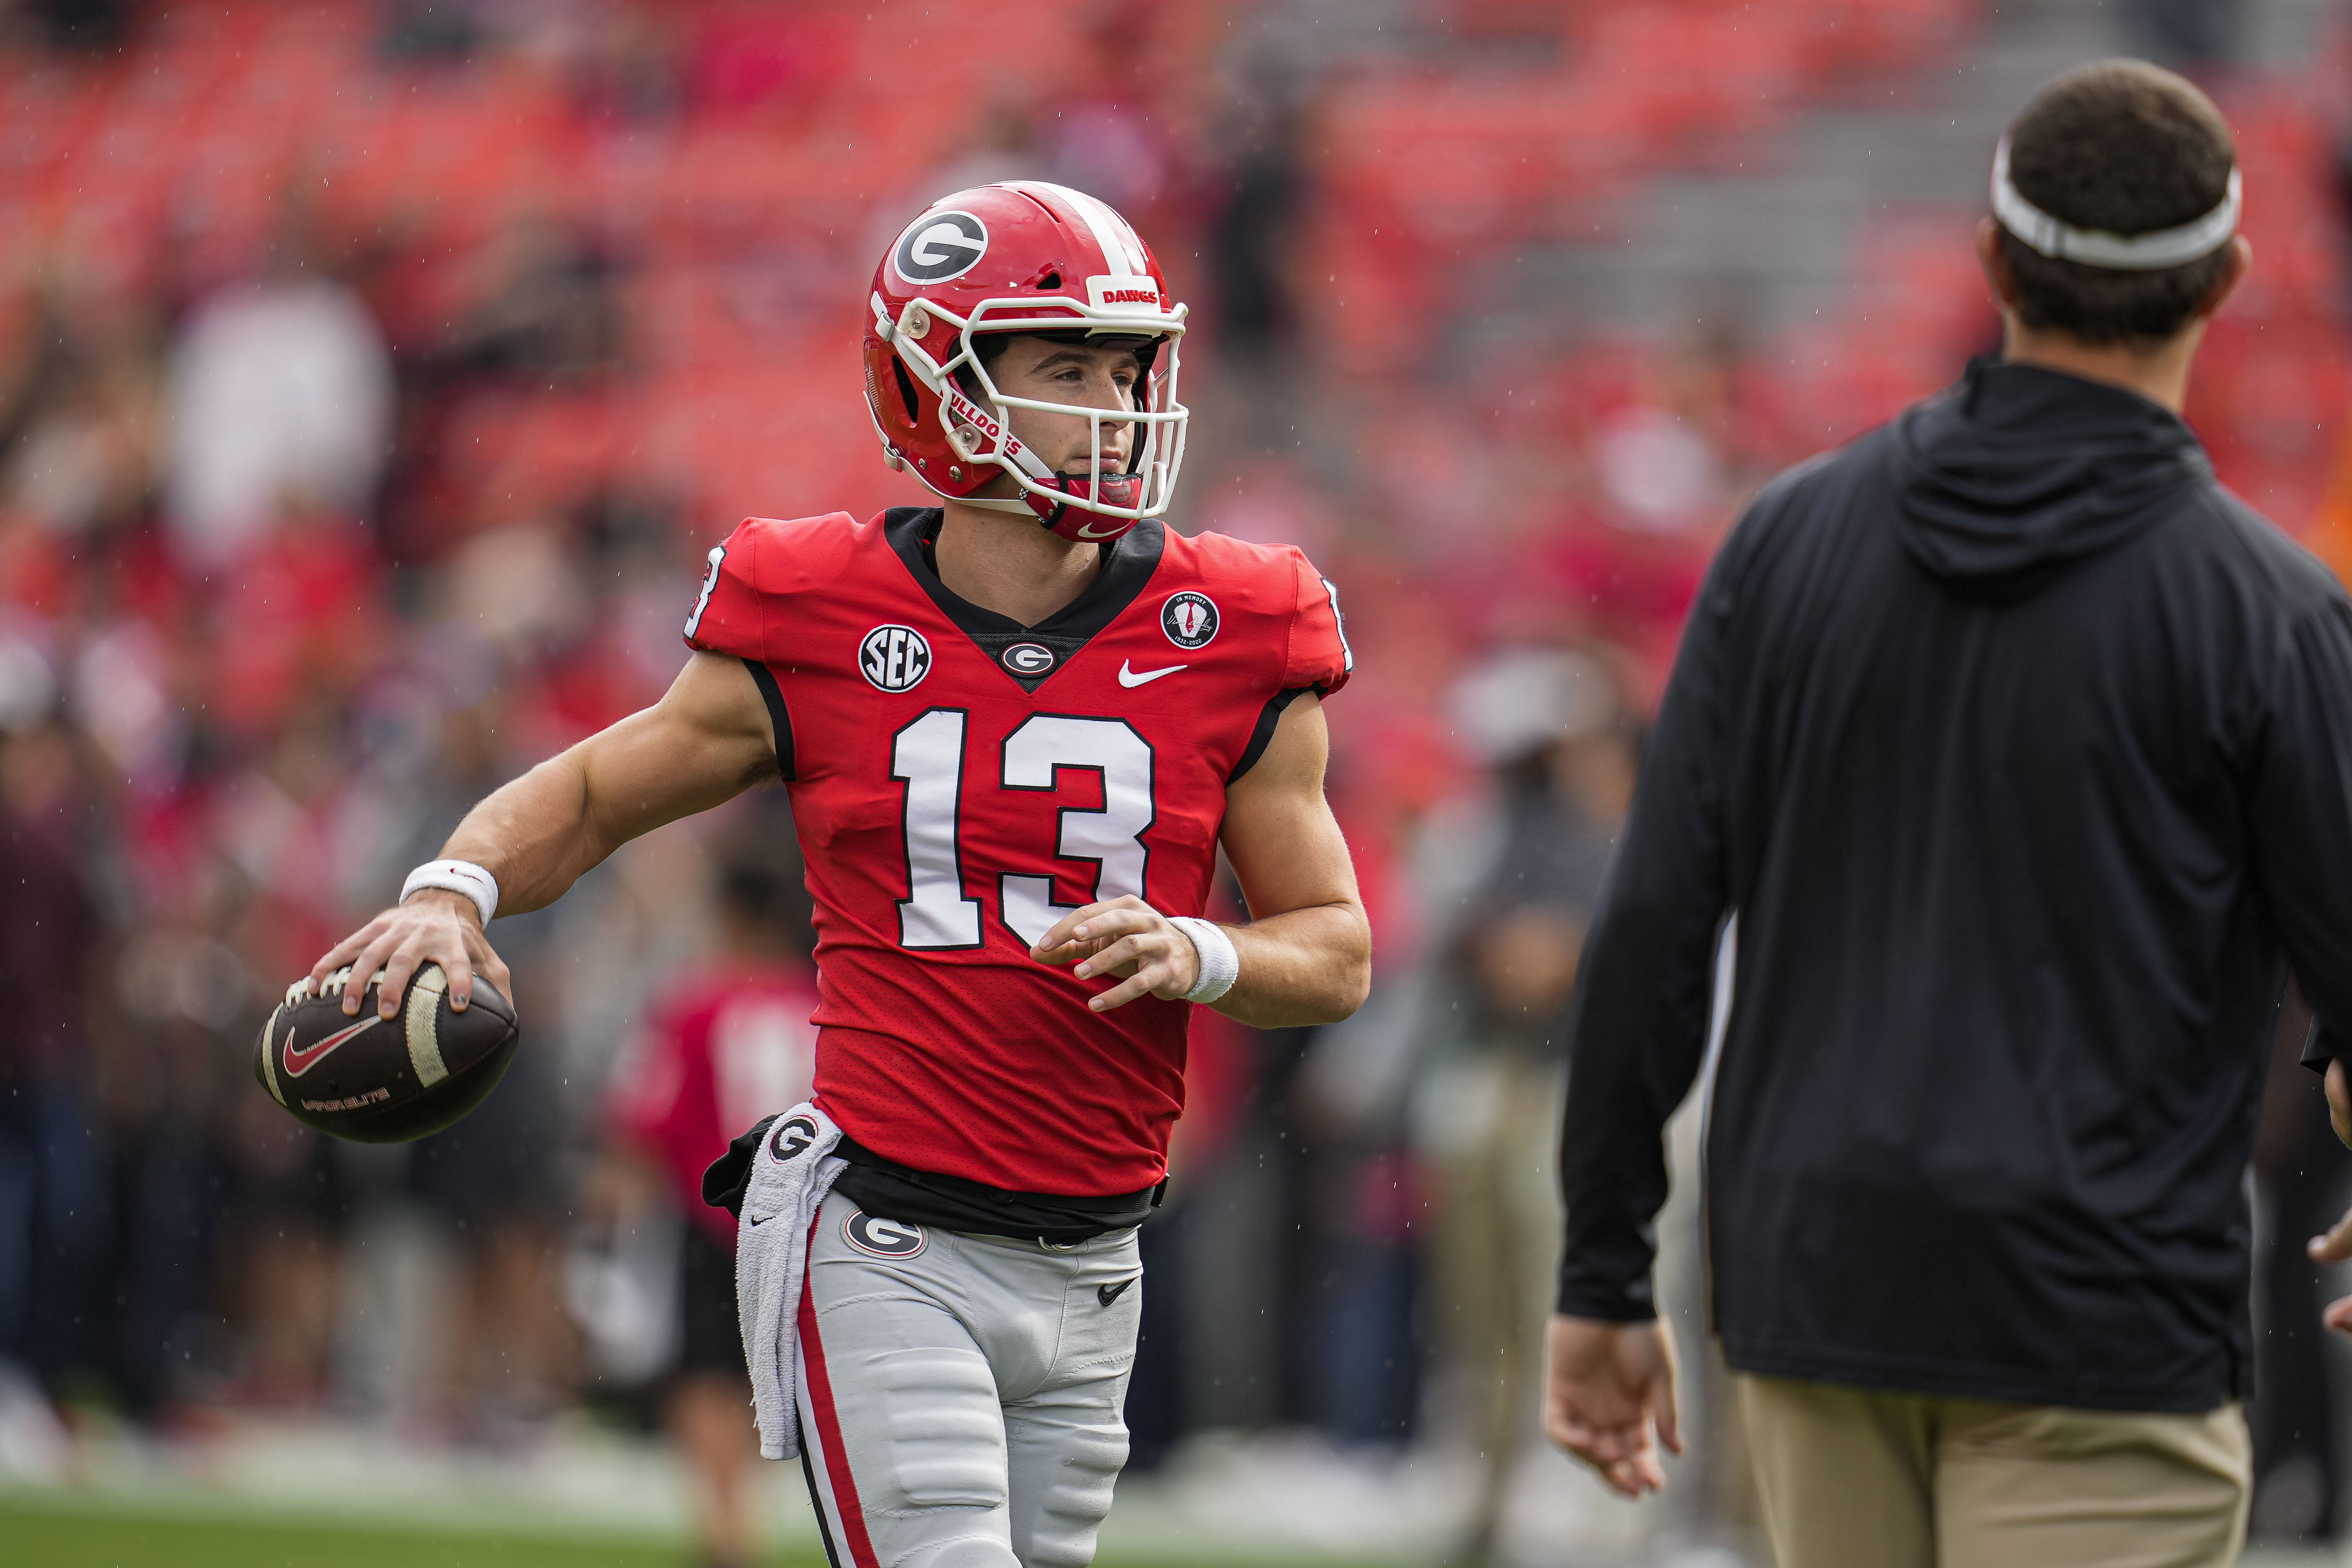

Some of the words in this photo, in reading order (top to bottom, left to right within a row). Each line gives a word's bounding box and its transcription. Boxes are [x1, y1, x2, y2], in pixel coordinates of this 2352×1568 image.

[897, 214, 984, 280] G
[1102, 289, 1158, 304] DAWGS
[939, 390, 1023, 455] ULLDOS
[1184, 596, 1207, 605] MEMORY
[865, 628, 926, 688] SEC
[1005, 645, 1052, 672] G
[1174, 635, 1202, 645] 1932-2022
[889, 706, 1157, 952] 13
[301, 1099, 346, 1112] VAPOR
[343, 1086, 391, 1110] ELITE
[771, 1118, 816, 1161] G
[849, 1212, 921, 1253] G
